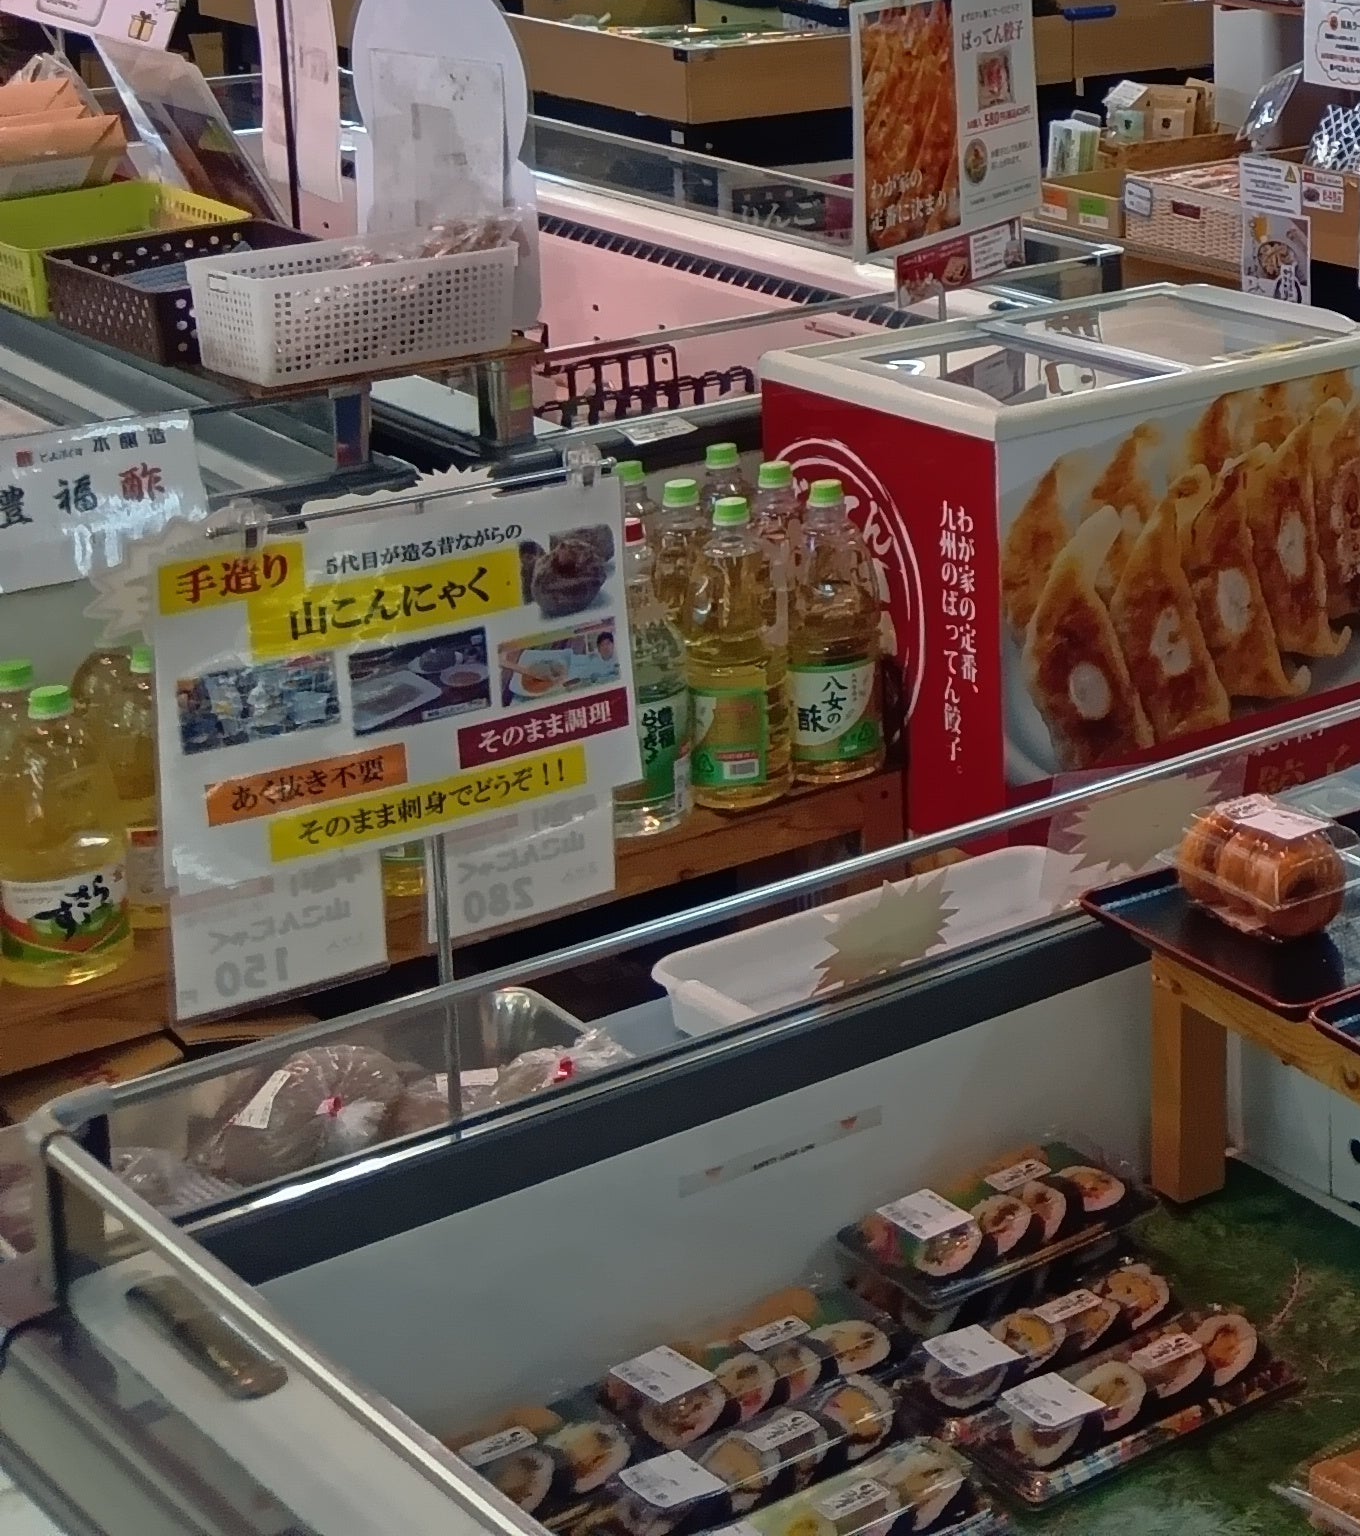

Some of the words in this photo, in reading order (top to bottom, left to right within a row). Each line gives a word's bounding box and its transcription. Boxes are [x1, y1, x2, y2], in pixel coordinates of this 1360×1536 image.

[961, 20, 1024, 52] ばってん餃子
[325, 522, 523, 576] 5代目が造る昔ながらの
[176, 553, 288, 604] 手造り
[290, 567, 491, 641] 山こんにゃく
[956, 506, 980, 695] わが家の定番、
[940, 500, 963, 775] 九州のばってん餃子。
[822, 674, 849, 725] 八女の
[478, 700, 612, 754] そのまま調理
[231, 757, 385, 812] あく抜き不要
[298, 758, 565, 845] そのまま刺身でどうぞ!!
